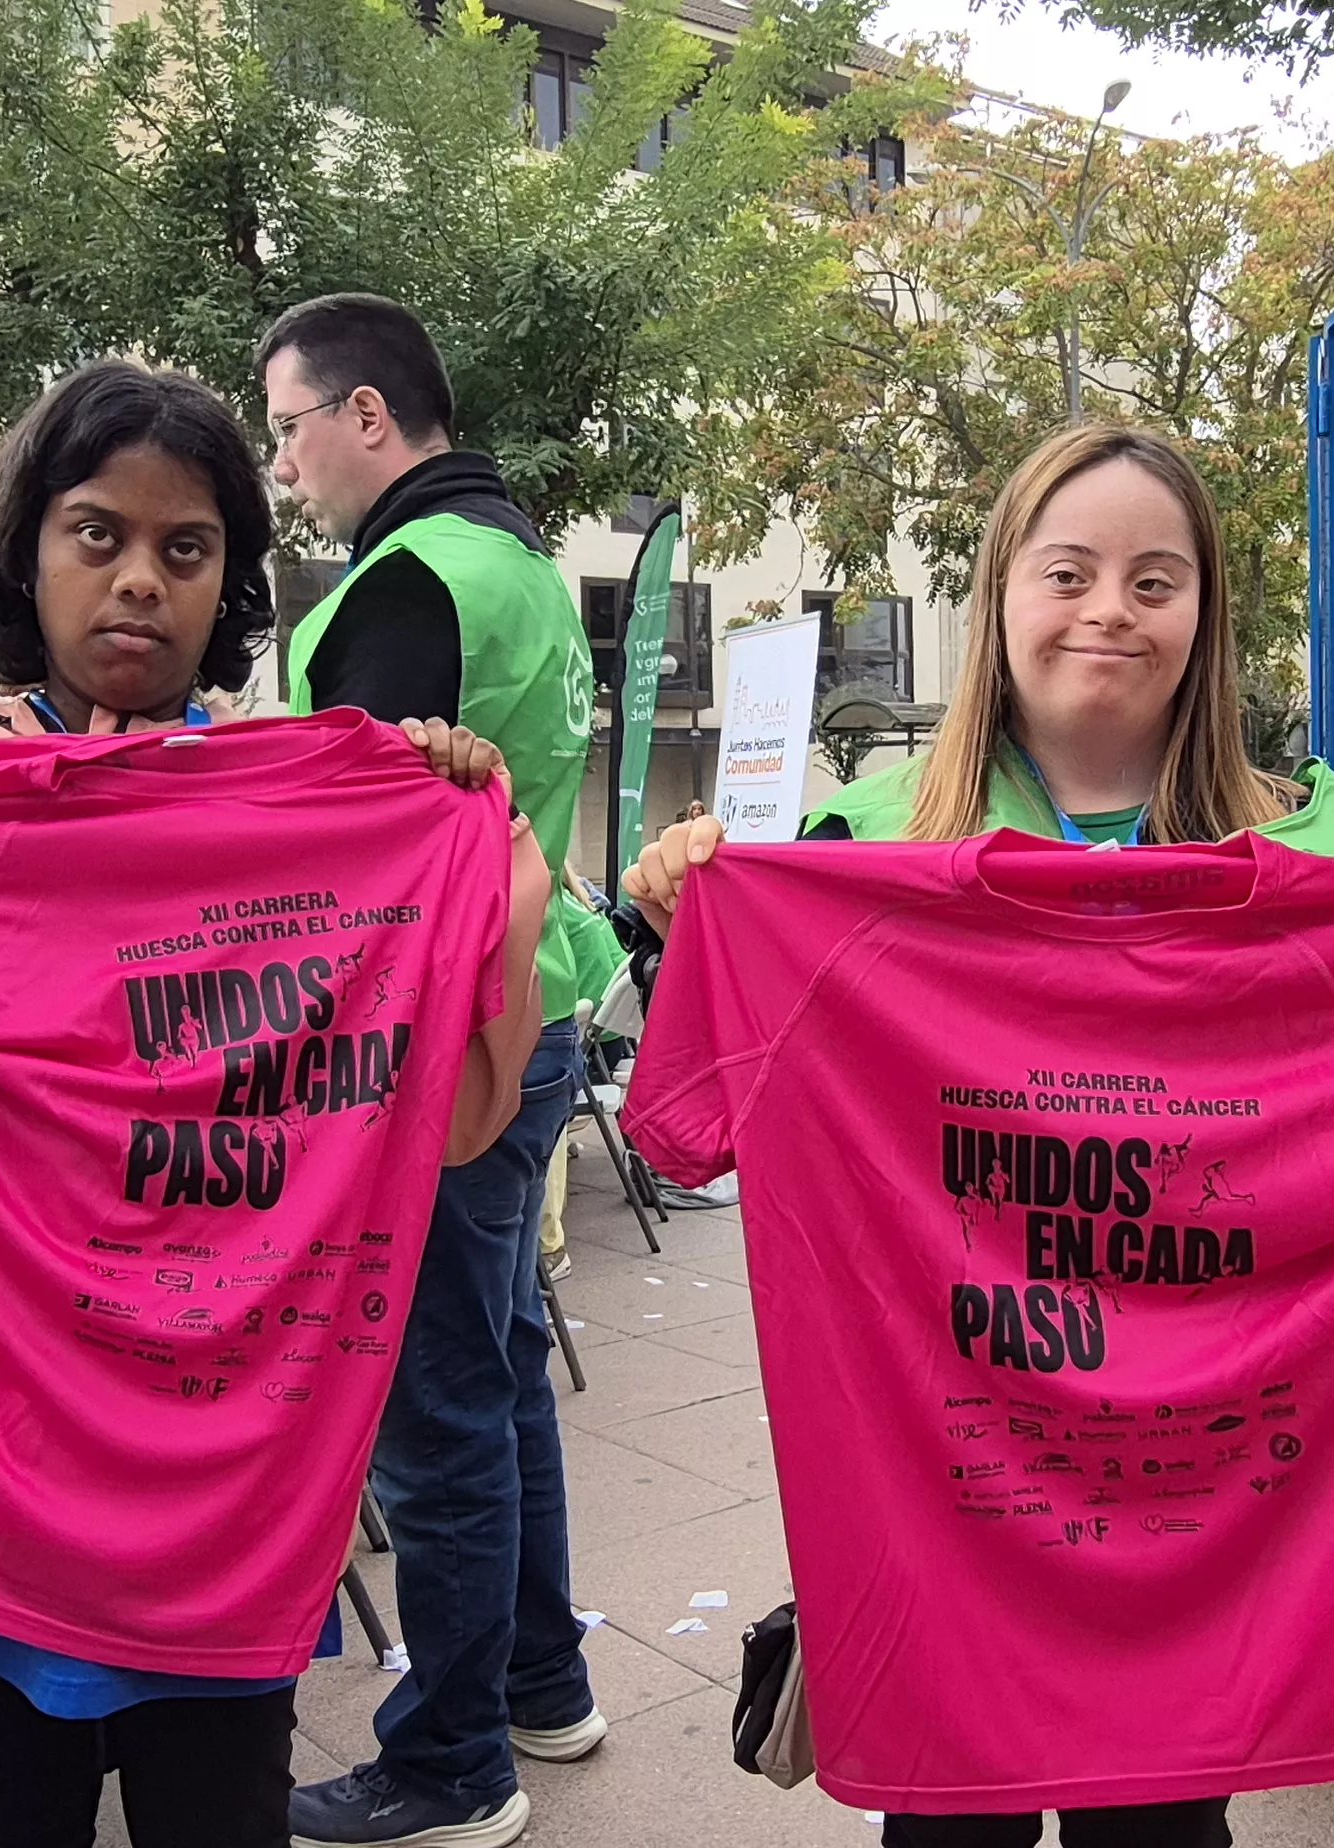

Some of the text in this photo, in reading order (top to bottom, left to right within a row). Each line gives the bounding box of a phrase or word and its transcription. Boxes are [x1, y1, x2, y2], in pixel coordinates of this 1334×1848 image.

[725, 751, 784, 775] Comunidad
[742, 802, 778, 819] amazon
[117, 905, 422, 962] HUESCA CONTRA EL CÁNCER
[199, 890, 339, 924] XII CARRERA
[125, 956, 335, 1063] UNIDOS
[215, 1039, 289, 1116] EN
[940, 1085, 1261, 1117] HUESCA CONTRA EL CÁNCER
[1027, 1068, 1168, 1093] XII CARRERA
[125, 1118, 287, 1211] PASO
[942, 1123, 1152, 1218] UNIDOS
[287, 1268, 336, 1282] URBAN
[1026, 1210, 1255, 1285] EN CADA
[951, 1283, 1106, 1373] PASO
